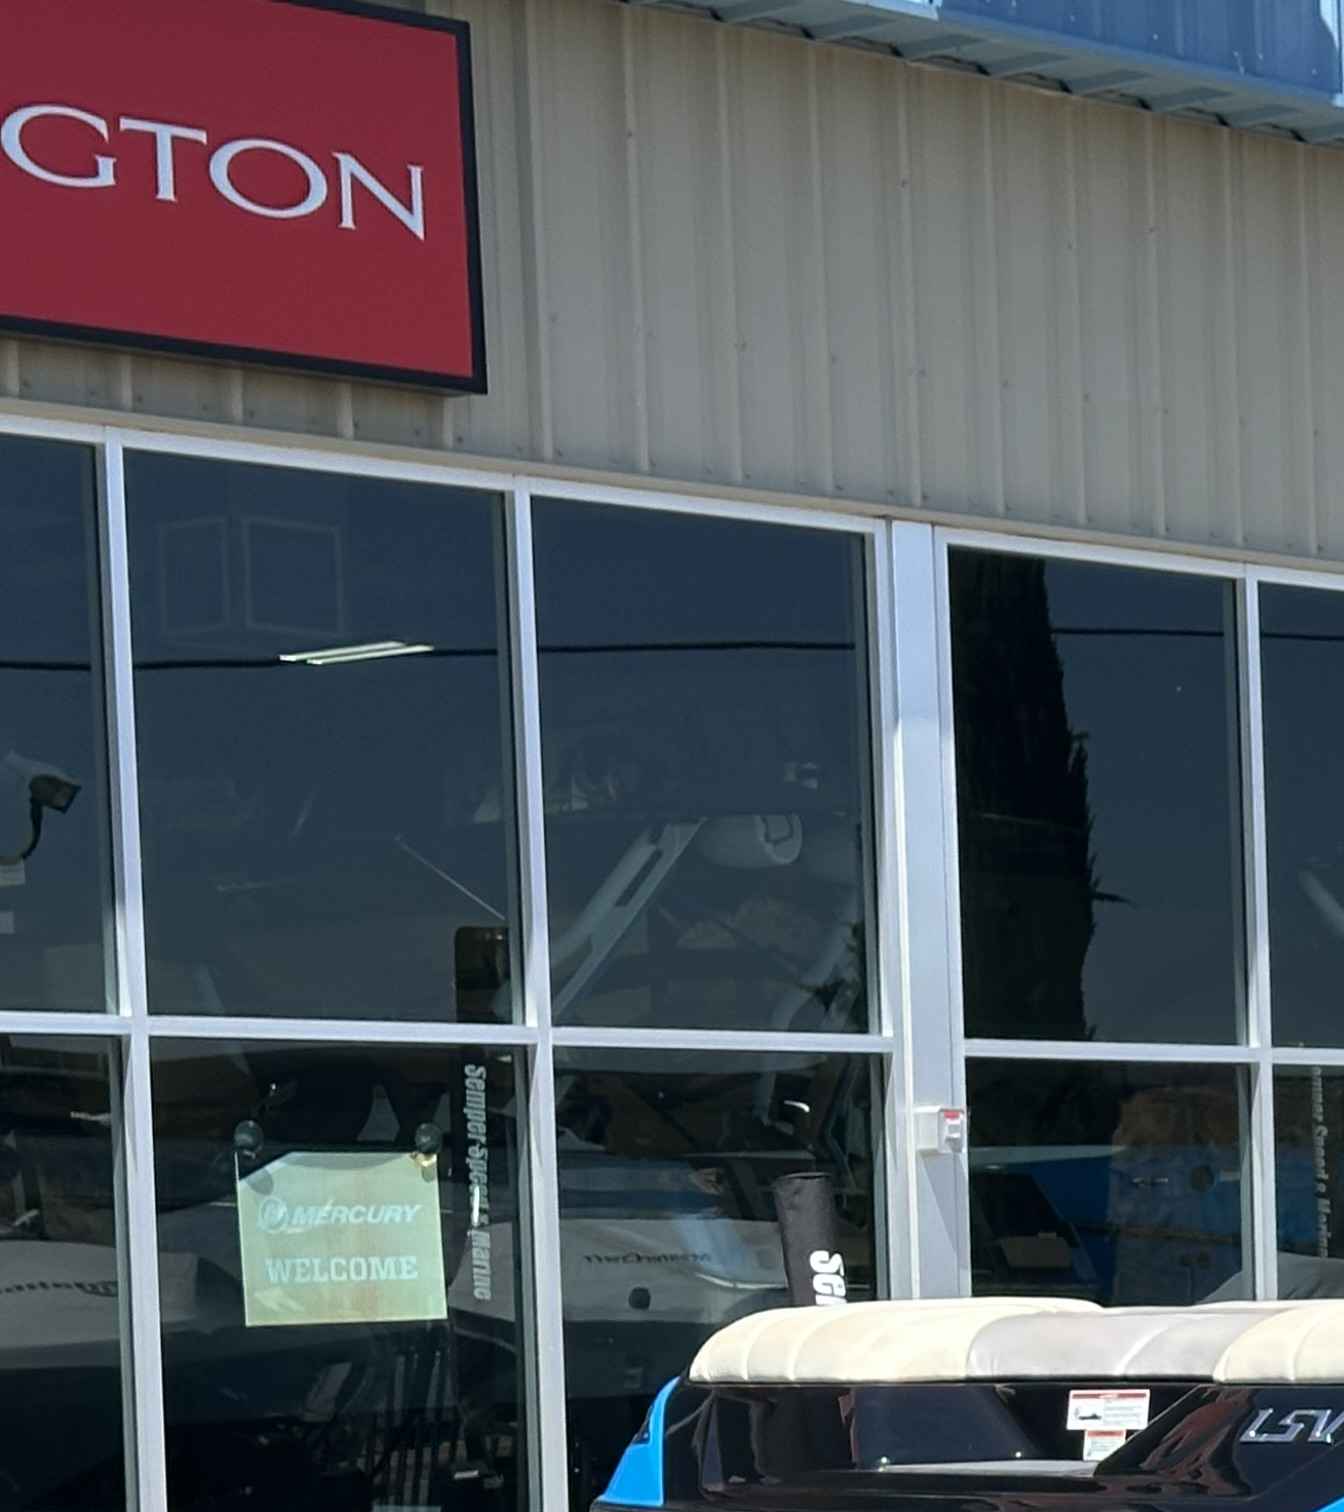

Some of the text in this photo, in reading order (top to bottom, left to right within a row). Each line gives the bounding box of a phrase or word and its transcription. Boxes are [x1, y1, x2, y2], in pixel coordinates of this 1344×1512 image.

[0, 104, 427, 241] GTON
[291, 1202, 423, 1226] MERCURY
[264, 1255, 419, 1284] WELCOME
